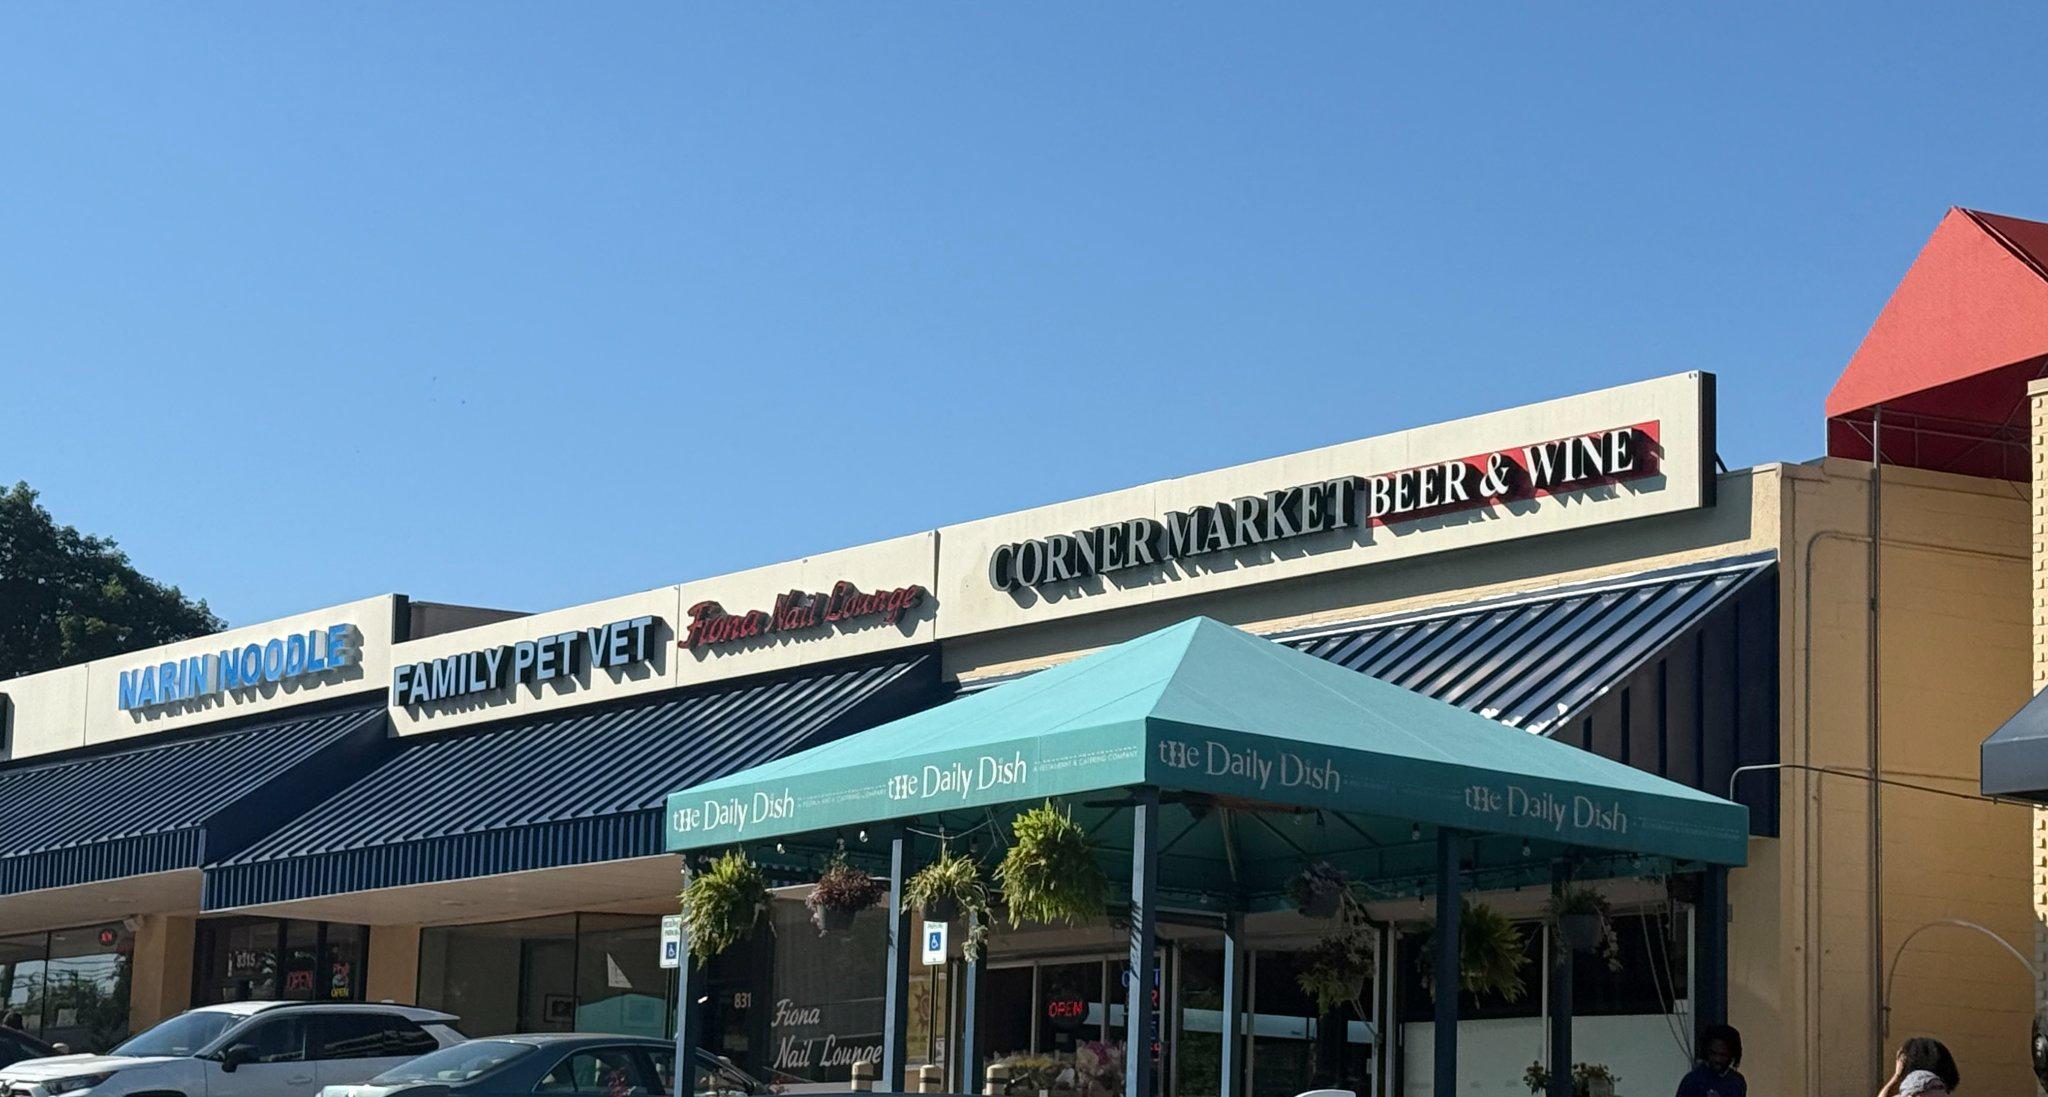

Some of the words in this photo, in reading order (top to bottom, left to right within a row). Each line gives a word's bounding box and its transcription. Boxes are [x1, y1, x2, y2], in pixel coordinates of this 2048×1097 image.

[1367, 460, 1470, 518] BEER
[1479, 451, 1510, 497] &
[1522, 427, 1635, 488] WINE
[989, 517, 1155, 592] CORNER
[1164, 475, 1358, 560] MARKET
[677, 600, 764, 649] Fiona
[765, 589, 820, 632] Nail
[824, 580, 920, 625] Lounge
[118, 653, 212, 710] NARIN
[219, 623, 352, 692] NOODLE
[393, 645, 508, 706] FAMILY
[514, 630, 580, 684] PET
[587, 614, 654, 669] VET
[921, 763, 974, 799] Daily
[976, 751, 1027, 791] Dish
[1205, 740, 1273, 790] Daily
[1280, 753, 1341, 793] Dish
[702, 798, 749, 832] Daily
[750, 787, 795, 824] Dish
[1507, 785, 1566, 832] Daily
[1573, 795, 1628, 834] Dish
[734, 992, 752, 1008] 831
[771, 998, 821, 1027] Fiona
[1048, 1001, 1083, 1018] OPEN
[773, 1034, 814, 1069] Nail
[819, 1033, 883, 1068] Lounge
